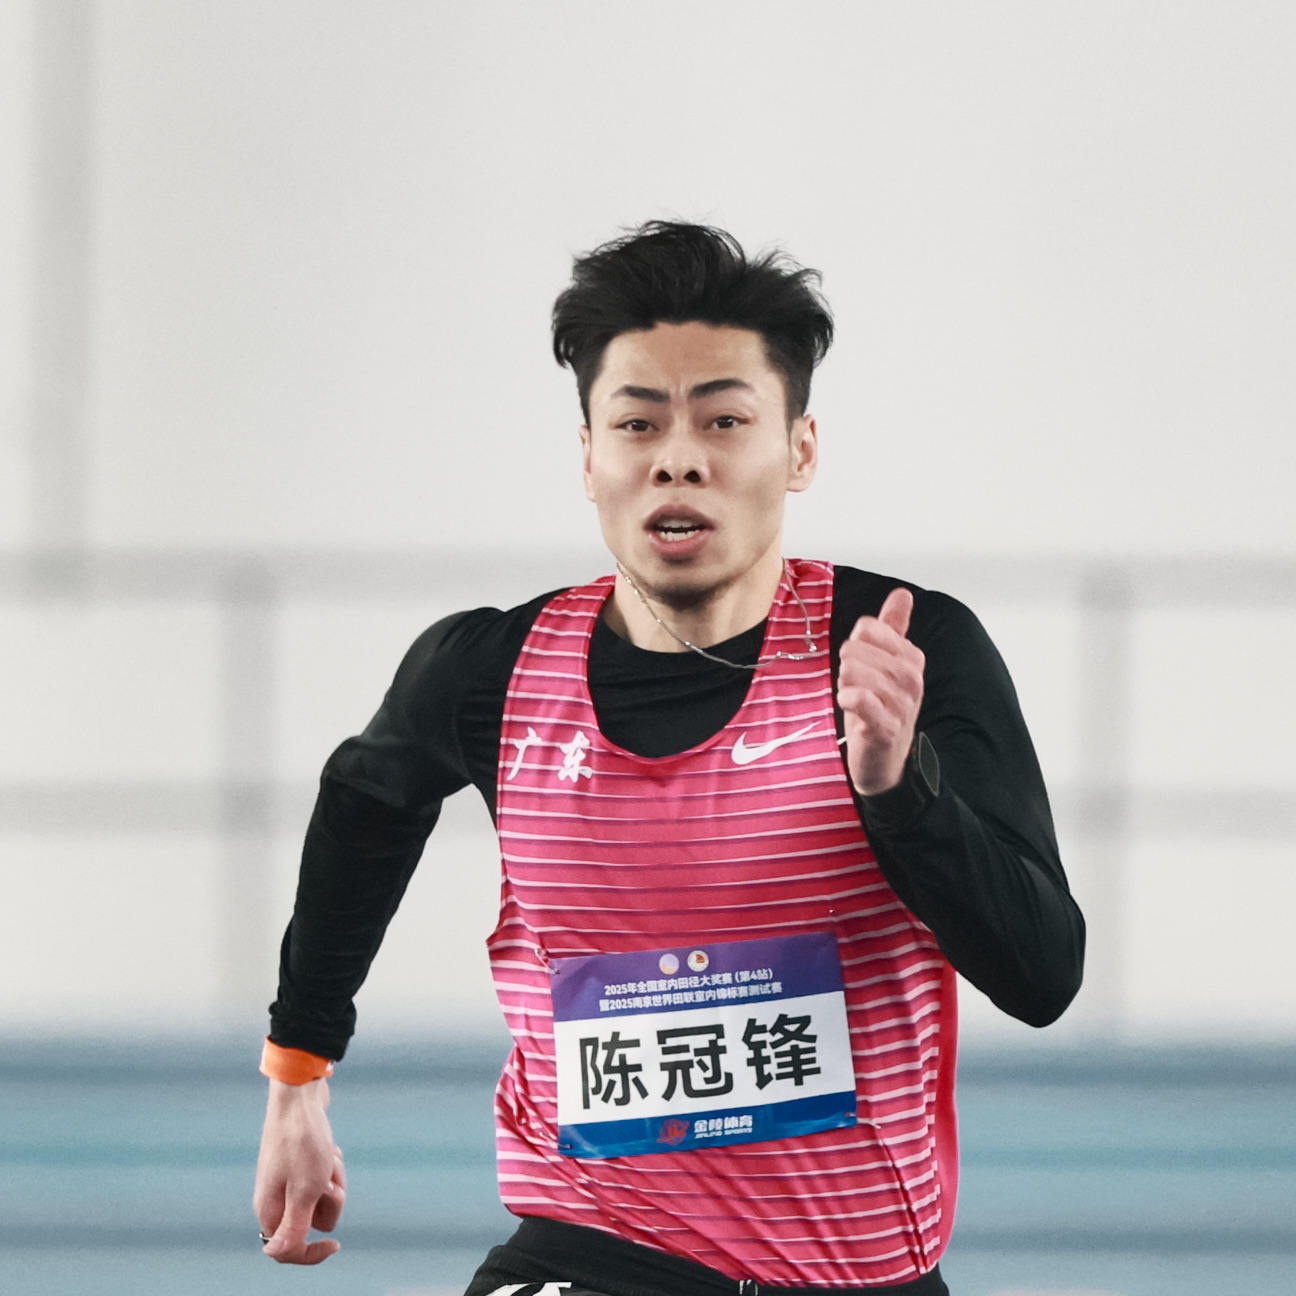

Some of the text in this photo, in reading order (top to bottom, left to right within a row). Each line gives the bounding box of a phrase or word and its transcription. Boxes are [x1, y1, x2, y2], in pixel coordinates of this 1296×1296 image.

[506, 725, 593, 782] 广东
[579, 1013, 821, 1110] 陈冠锋
